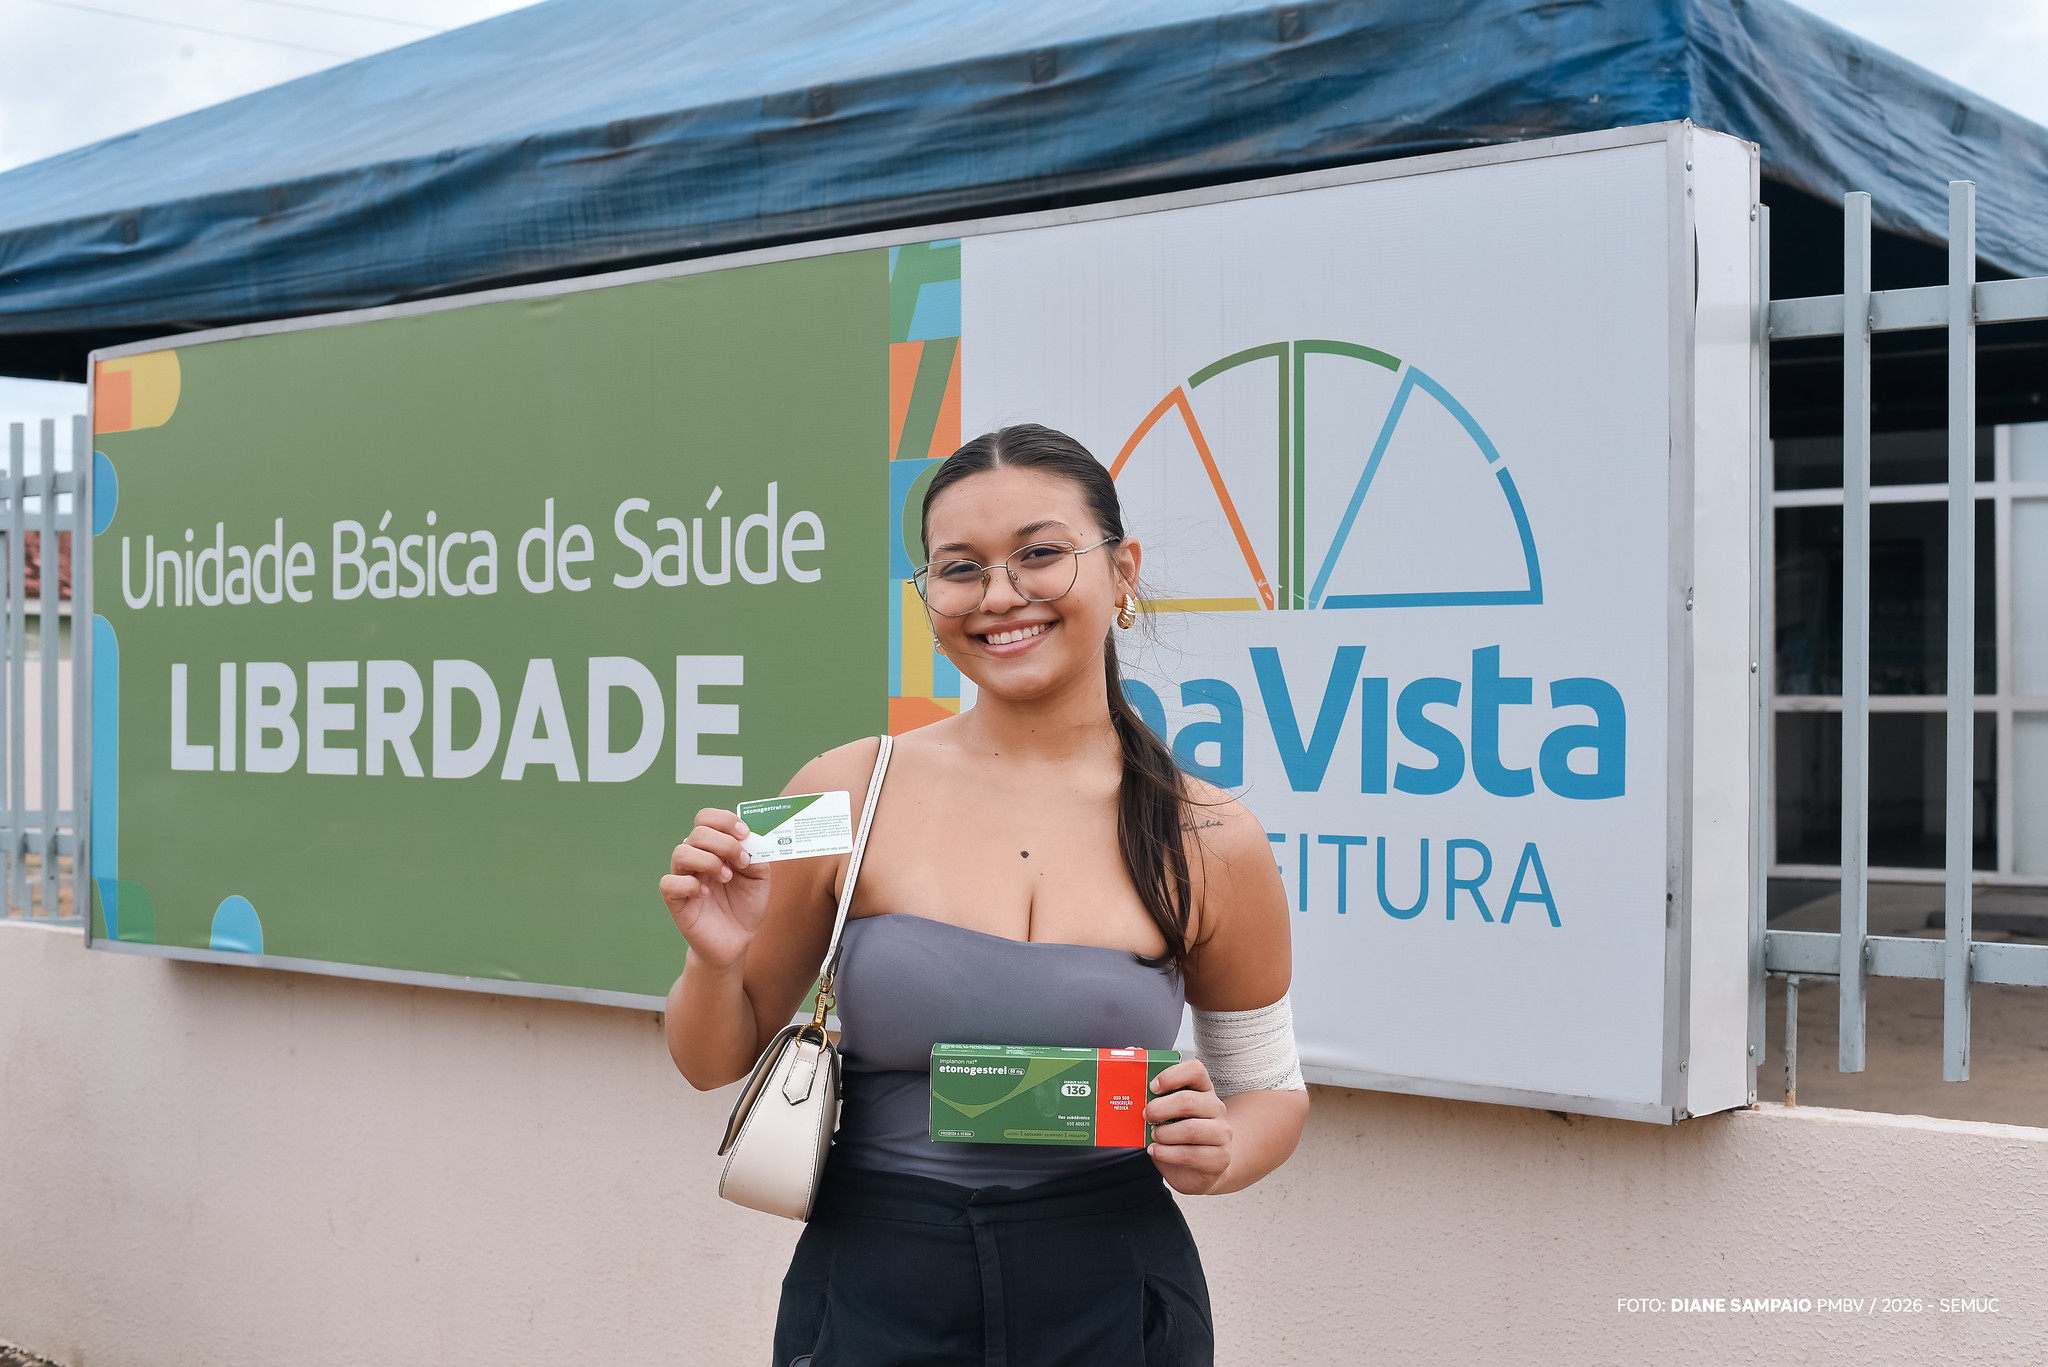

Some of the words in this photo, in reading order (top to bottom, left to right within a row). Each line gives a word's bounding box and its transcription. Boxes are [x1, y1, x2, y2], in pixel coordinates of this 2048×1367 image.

[122, 517, 316, 610] Unidade
[332, 509, 498, 601] Básica
[517, 497, 595, 594] de
[613, 480, 826, 589] Saúde
[171, 655, 744, 787] LIBERDADE
[939, 1065, 1007, 1076] etonogestrel
[1066, 1086, 1086, 1095] 136
